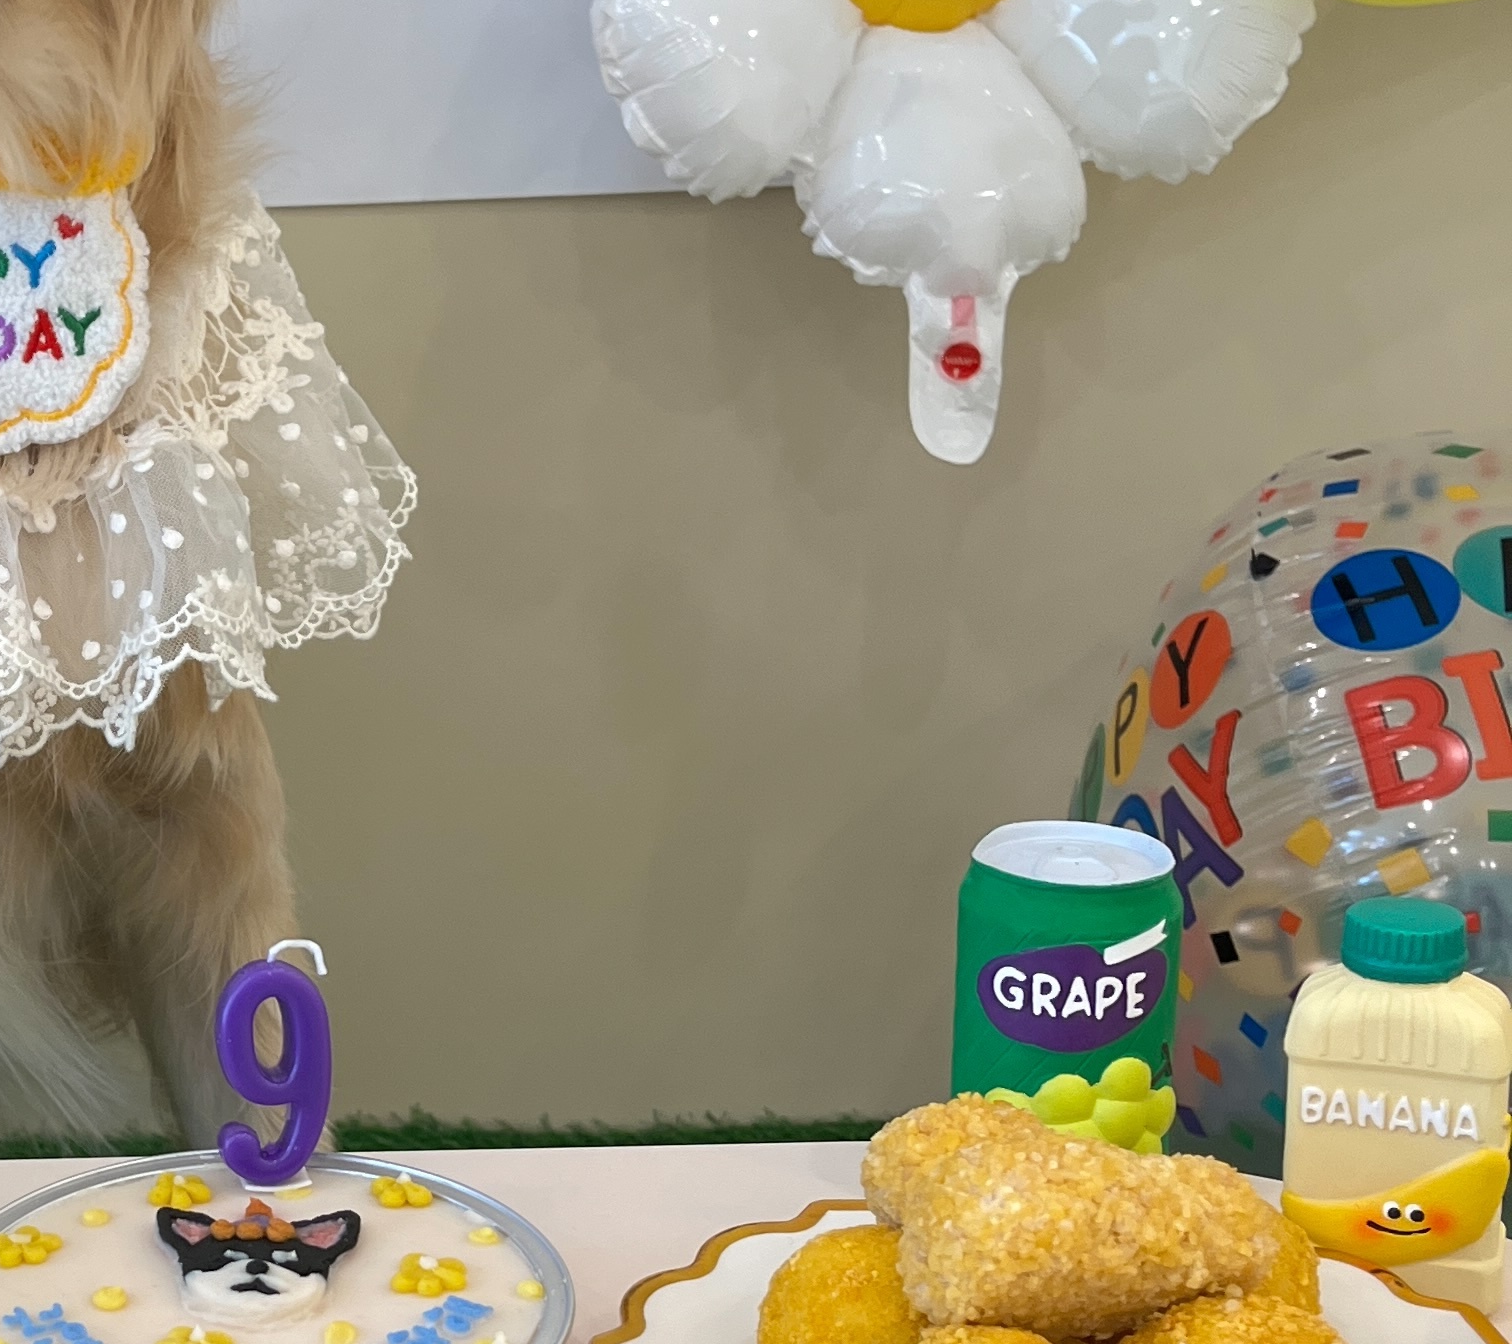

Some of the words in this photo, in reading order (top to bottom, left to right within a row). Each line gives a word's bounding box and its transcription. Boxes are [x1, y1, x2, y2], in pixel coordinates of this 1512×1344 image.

[992, 966, 1147, 1020] GRAPE
[215, 959, 331, 1184] 9
[1300, 1085, 1481, 1142] BANANA
